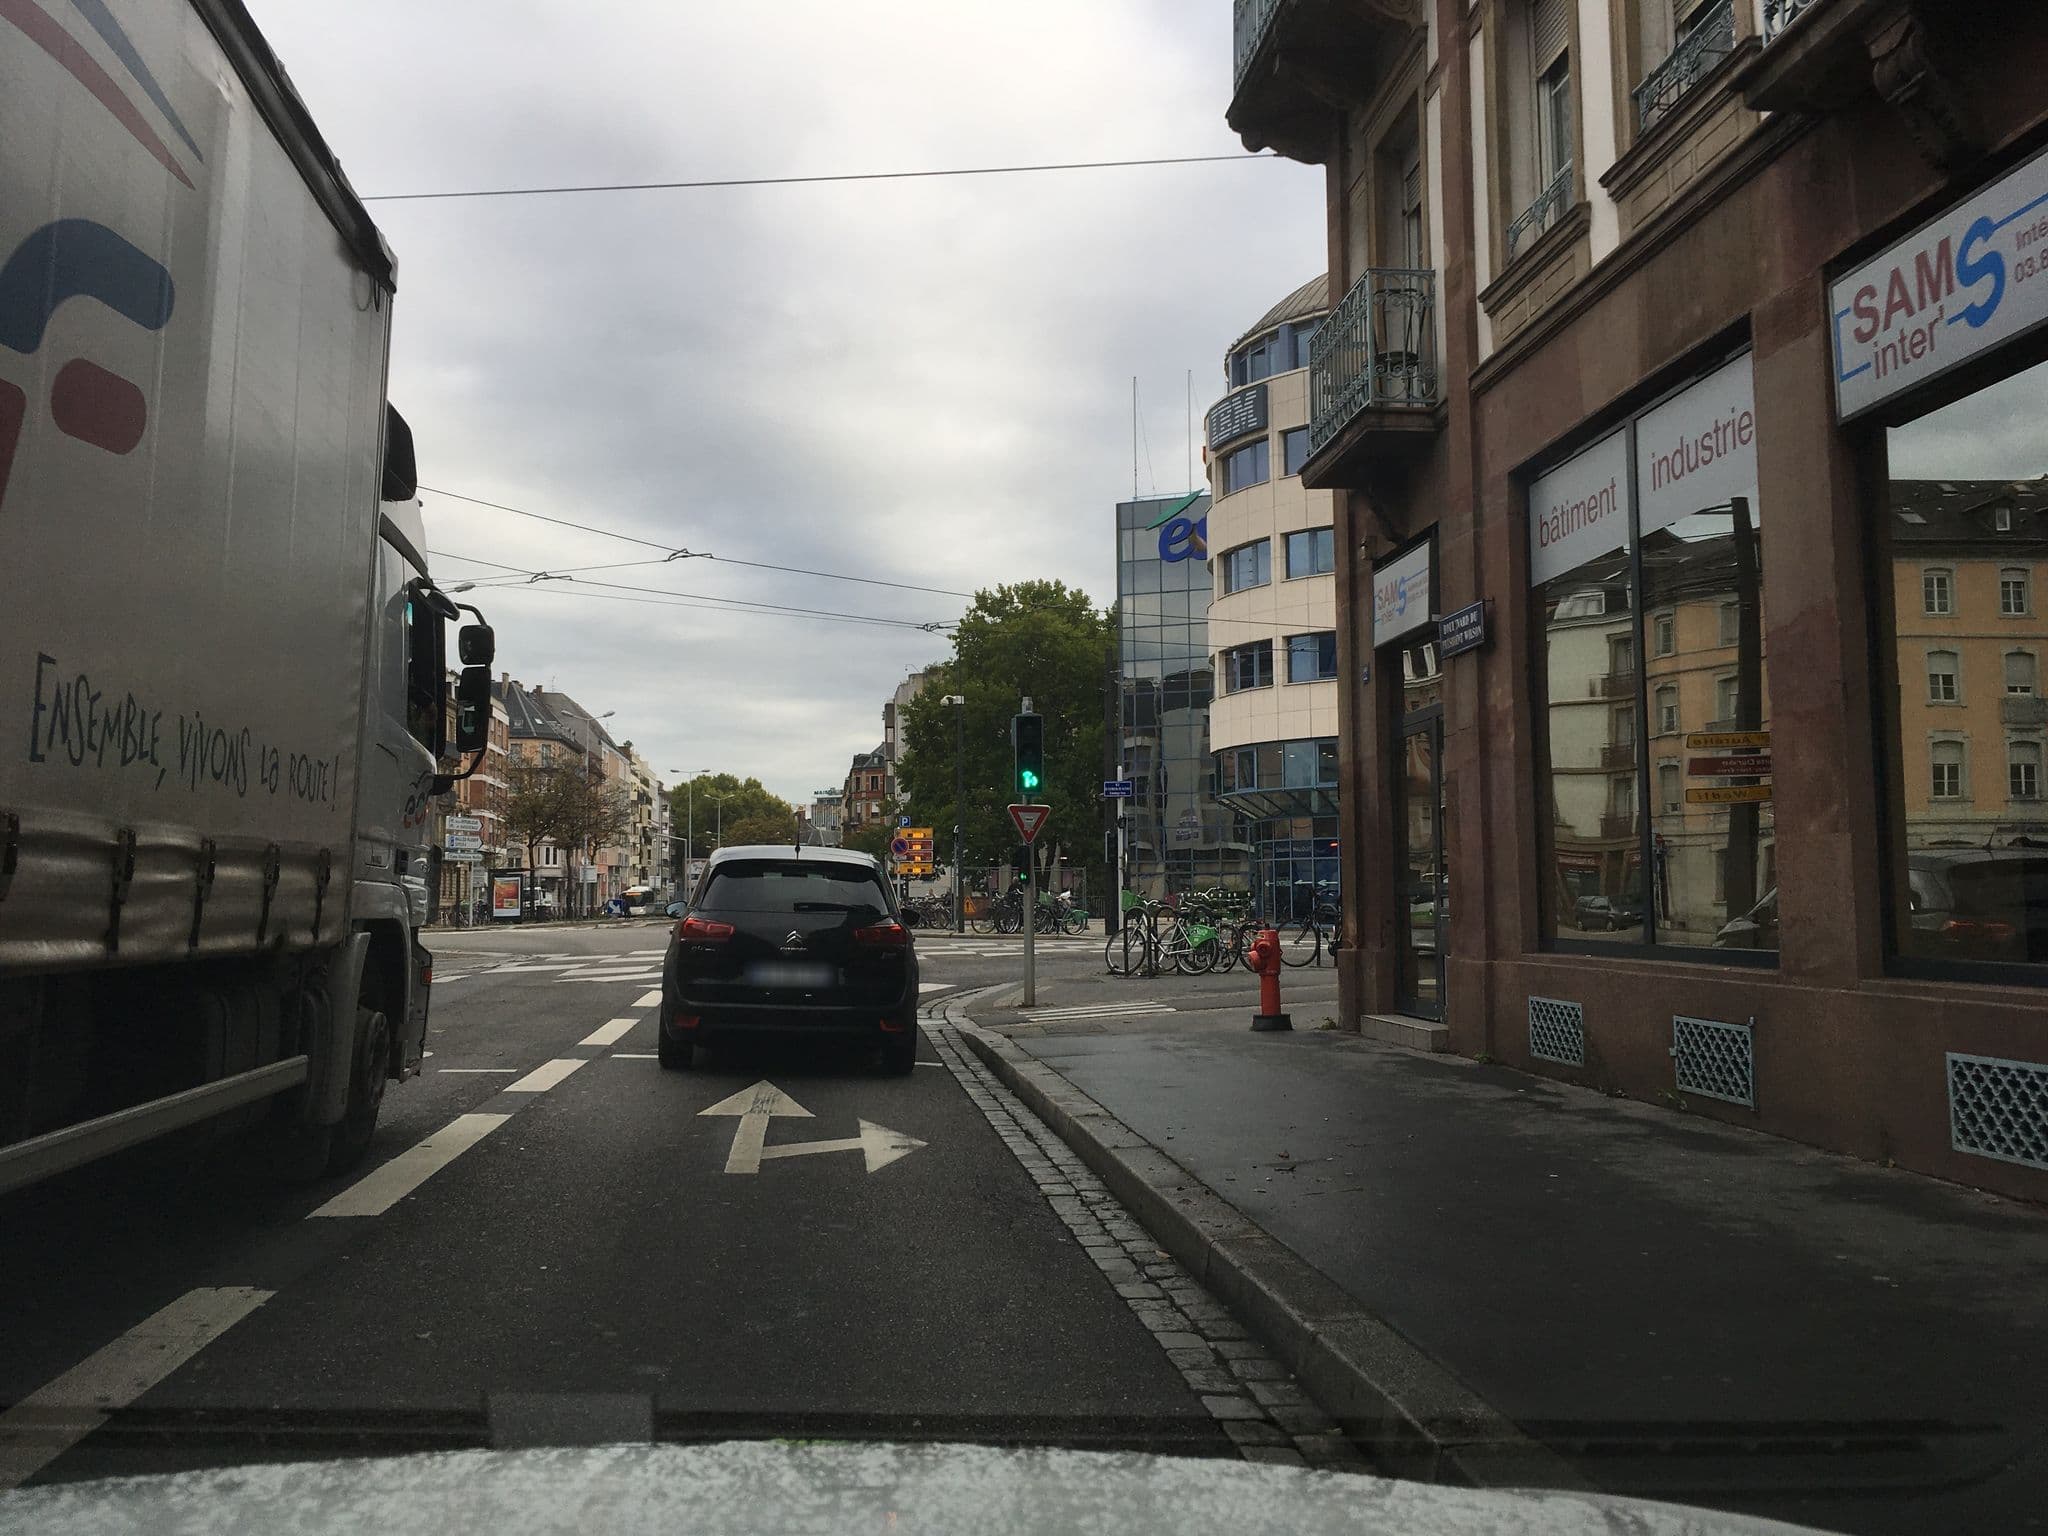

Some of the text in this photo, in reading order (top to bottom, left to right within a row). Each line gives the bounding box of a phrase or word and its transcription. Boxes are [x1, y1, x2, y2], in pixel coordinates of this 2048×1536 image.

[1853, 216, 2006, 344] SAMS
[1211, 390, 1258, 446] IBM
[1652, 406, 1754, 491] industrie
[1539, 477, 1617, 548] bâtiment
[30, 652, 162, 792] ENSEMBLE,
